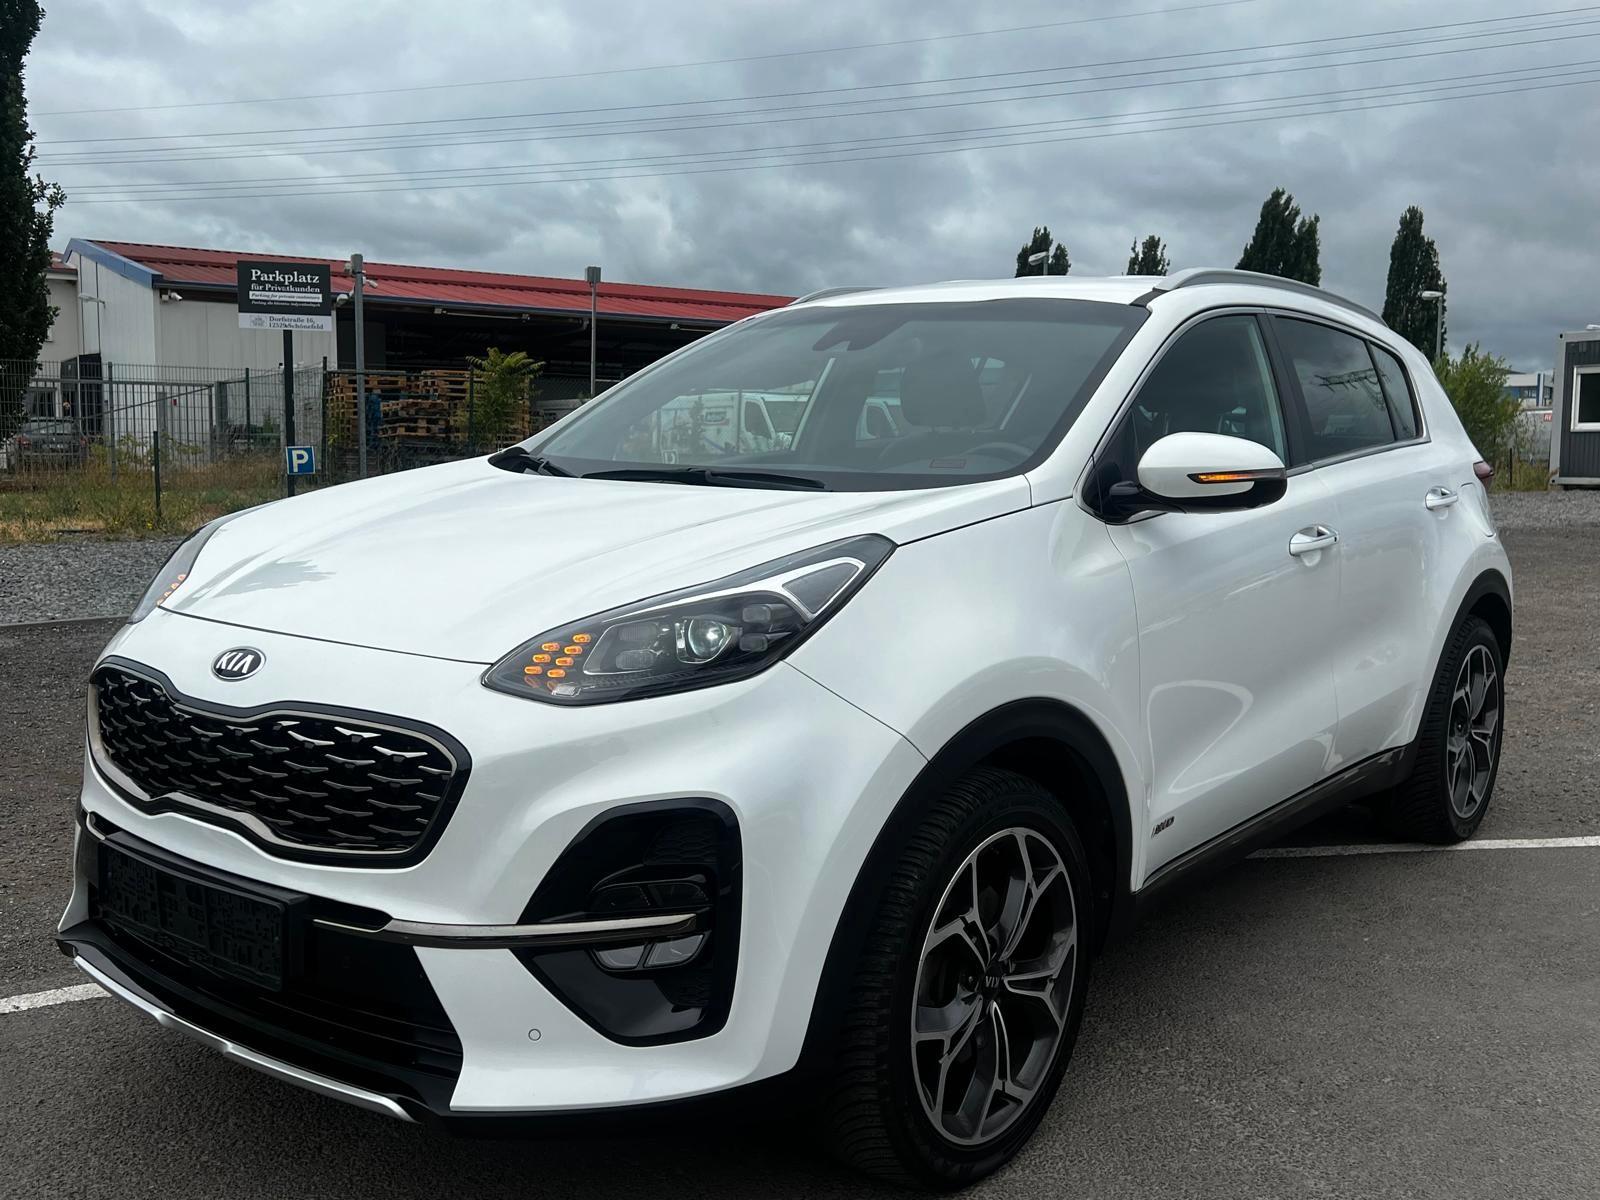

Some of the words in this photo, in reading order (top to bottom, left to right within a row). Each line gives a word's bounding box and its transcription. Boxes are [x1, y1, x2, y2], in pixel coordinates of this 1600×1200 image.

[251, 269, 320, 285] Parkplatz
[266, 284, 320, 292] Privatkunden
[292, 450, 309, 473] P
[215, 651, 255, 674] KIA
